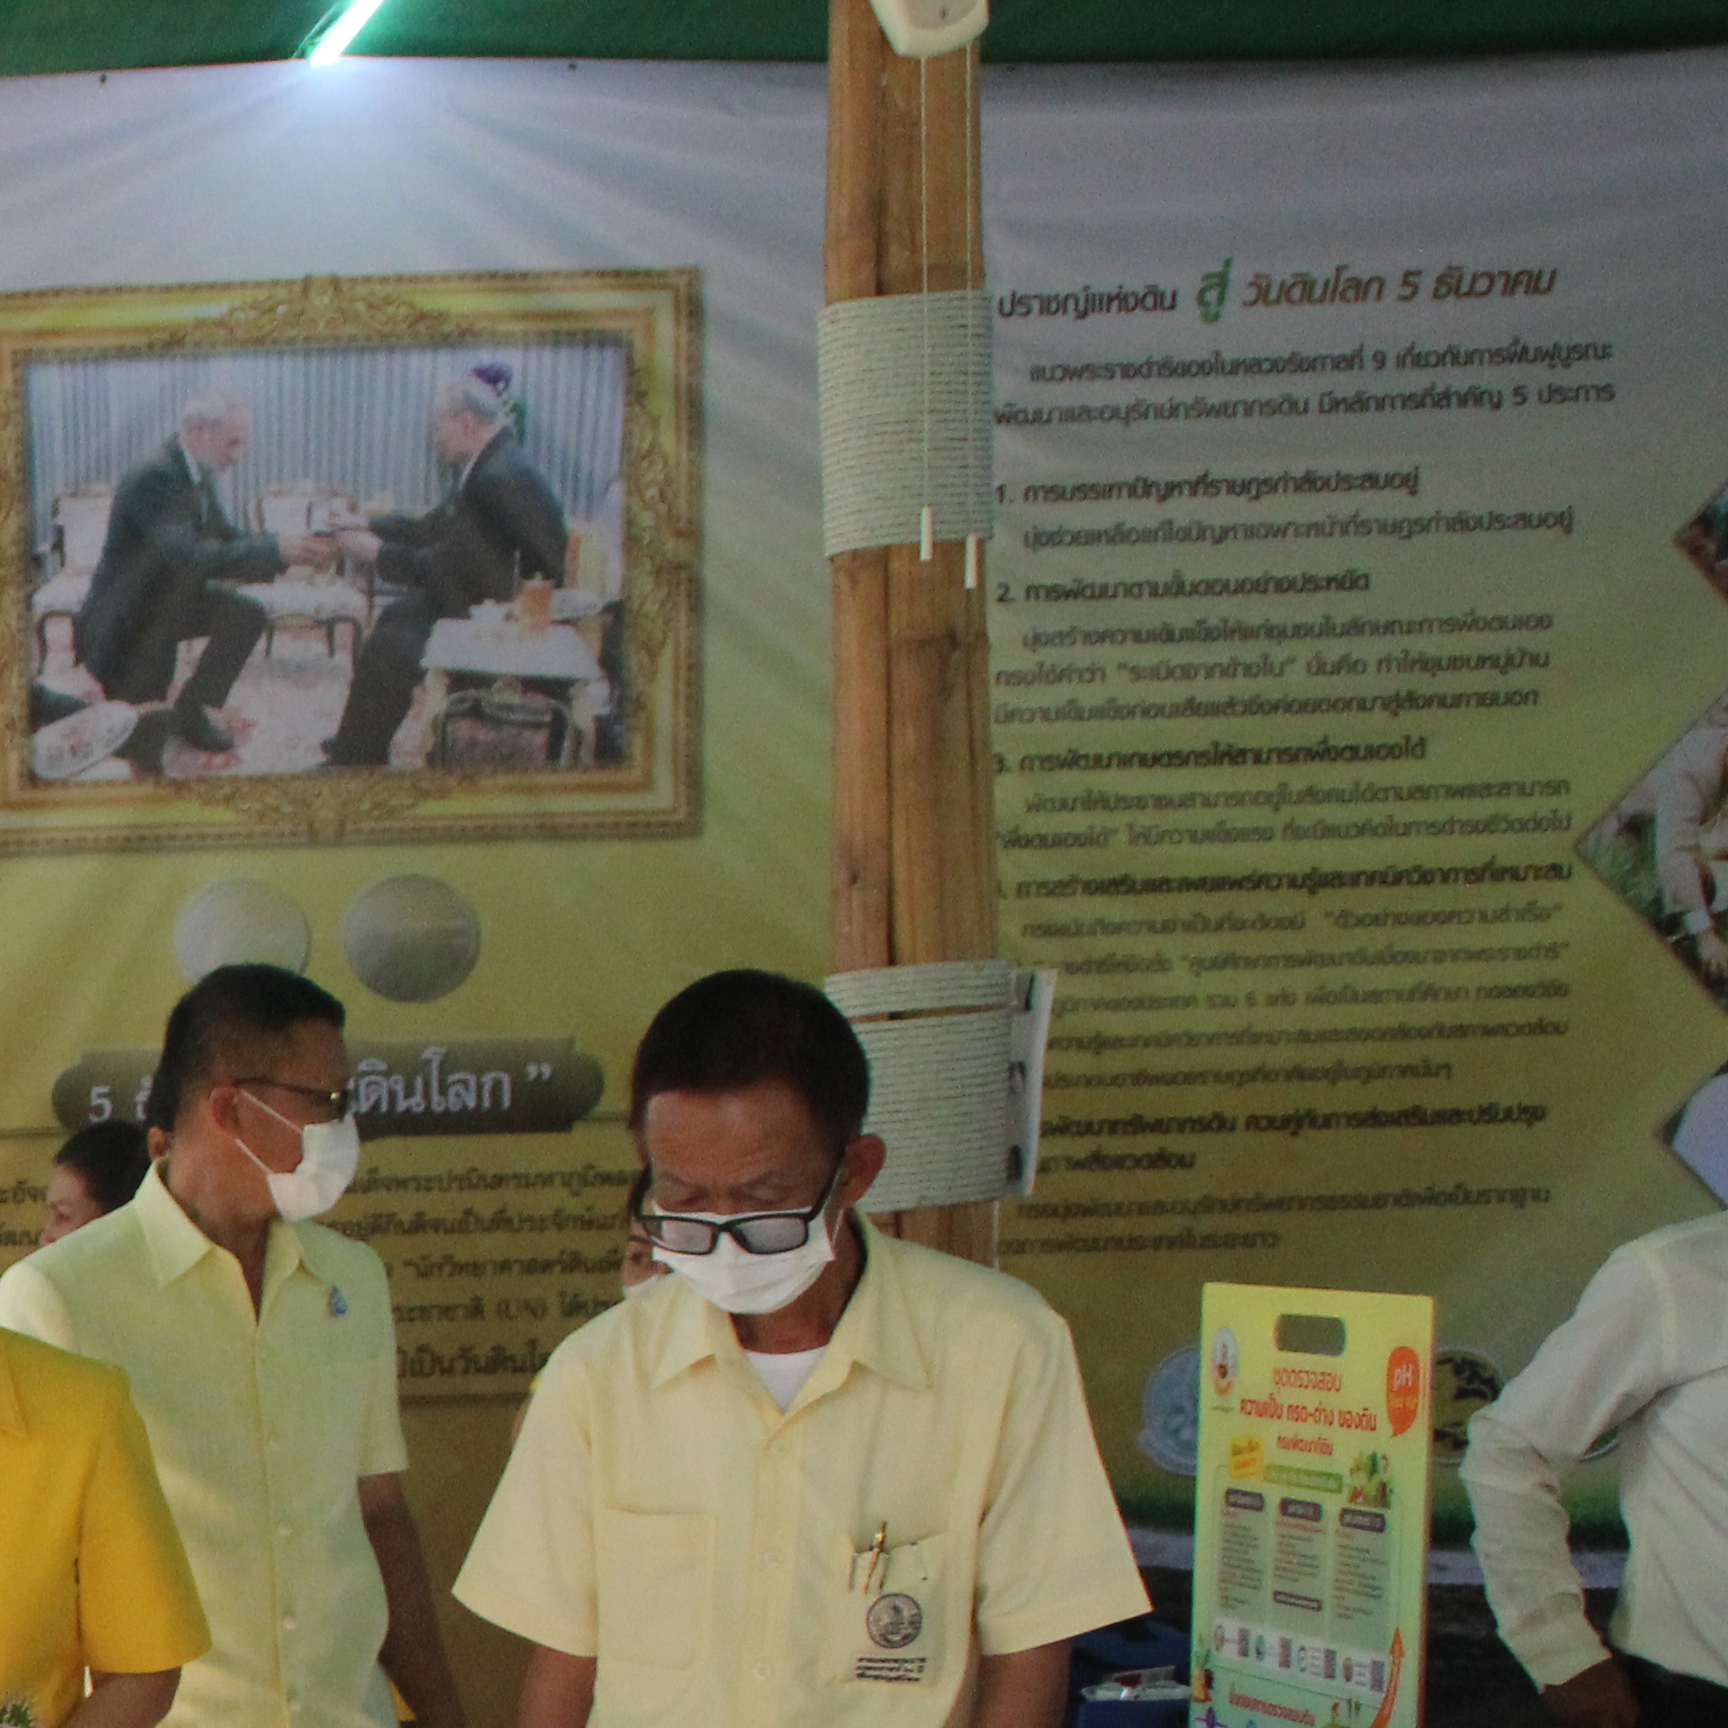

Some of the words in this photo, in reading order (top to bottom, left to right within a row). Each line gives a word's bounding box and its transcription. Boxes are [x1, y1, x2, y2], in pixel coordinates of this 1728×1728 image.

[998, 285, 1177, 320] ปราชญ์แห่งดิน
[1197, 256, 1233, 323] สู่
[1243, 264, 1386, 307] วันดินโลก
[1398, 269, 1422, 301] 5
[1433, 264, 1558, 300] ธันวาคม
[1372, 348, 1387, 371] 9
[1513, 385, 1528, 406] 5
[1537, 382, 1616, 404] ประการ
[996, 484, 1014, 504] 1.
[996, 582, 1015, 602] 2.
[89, 1086, 113, 1122] 5
[1393, 1364, 1413, 1391] pH
[1338, 1407, 1377, 1431] ของดิน
